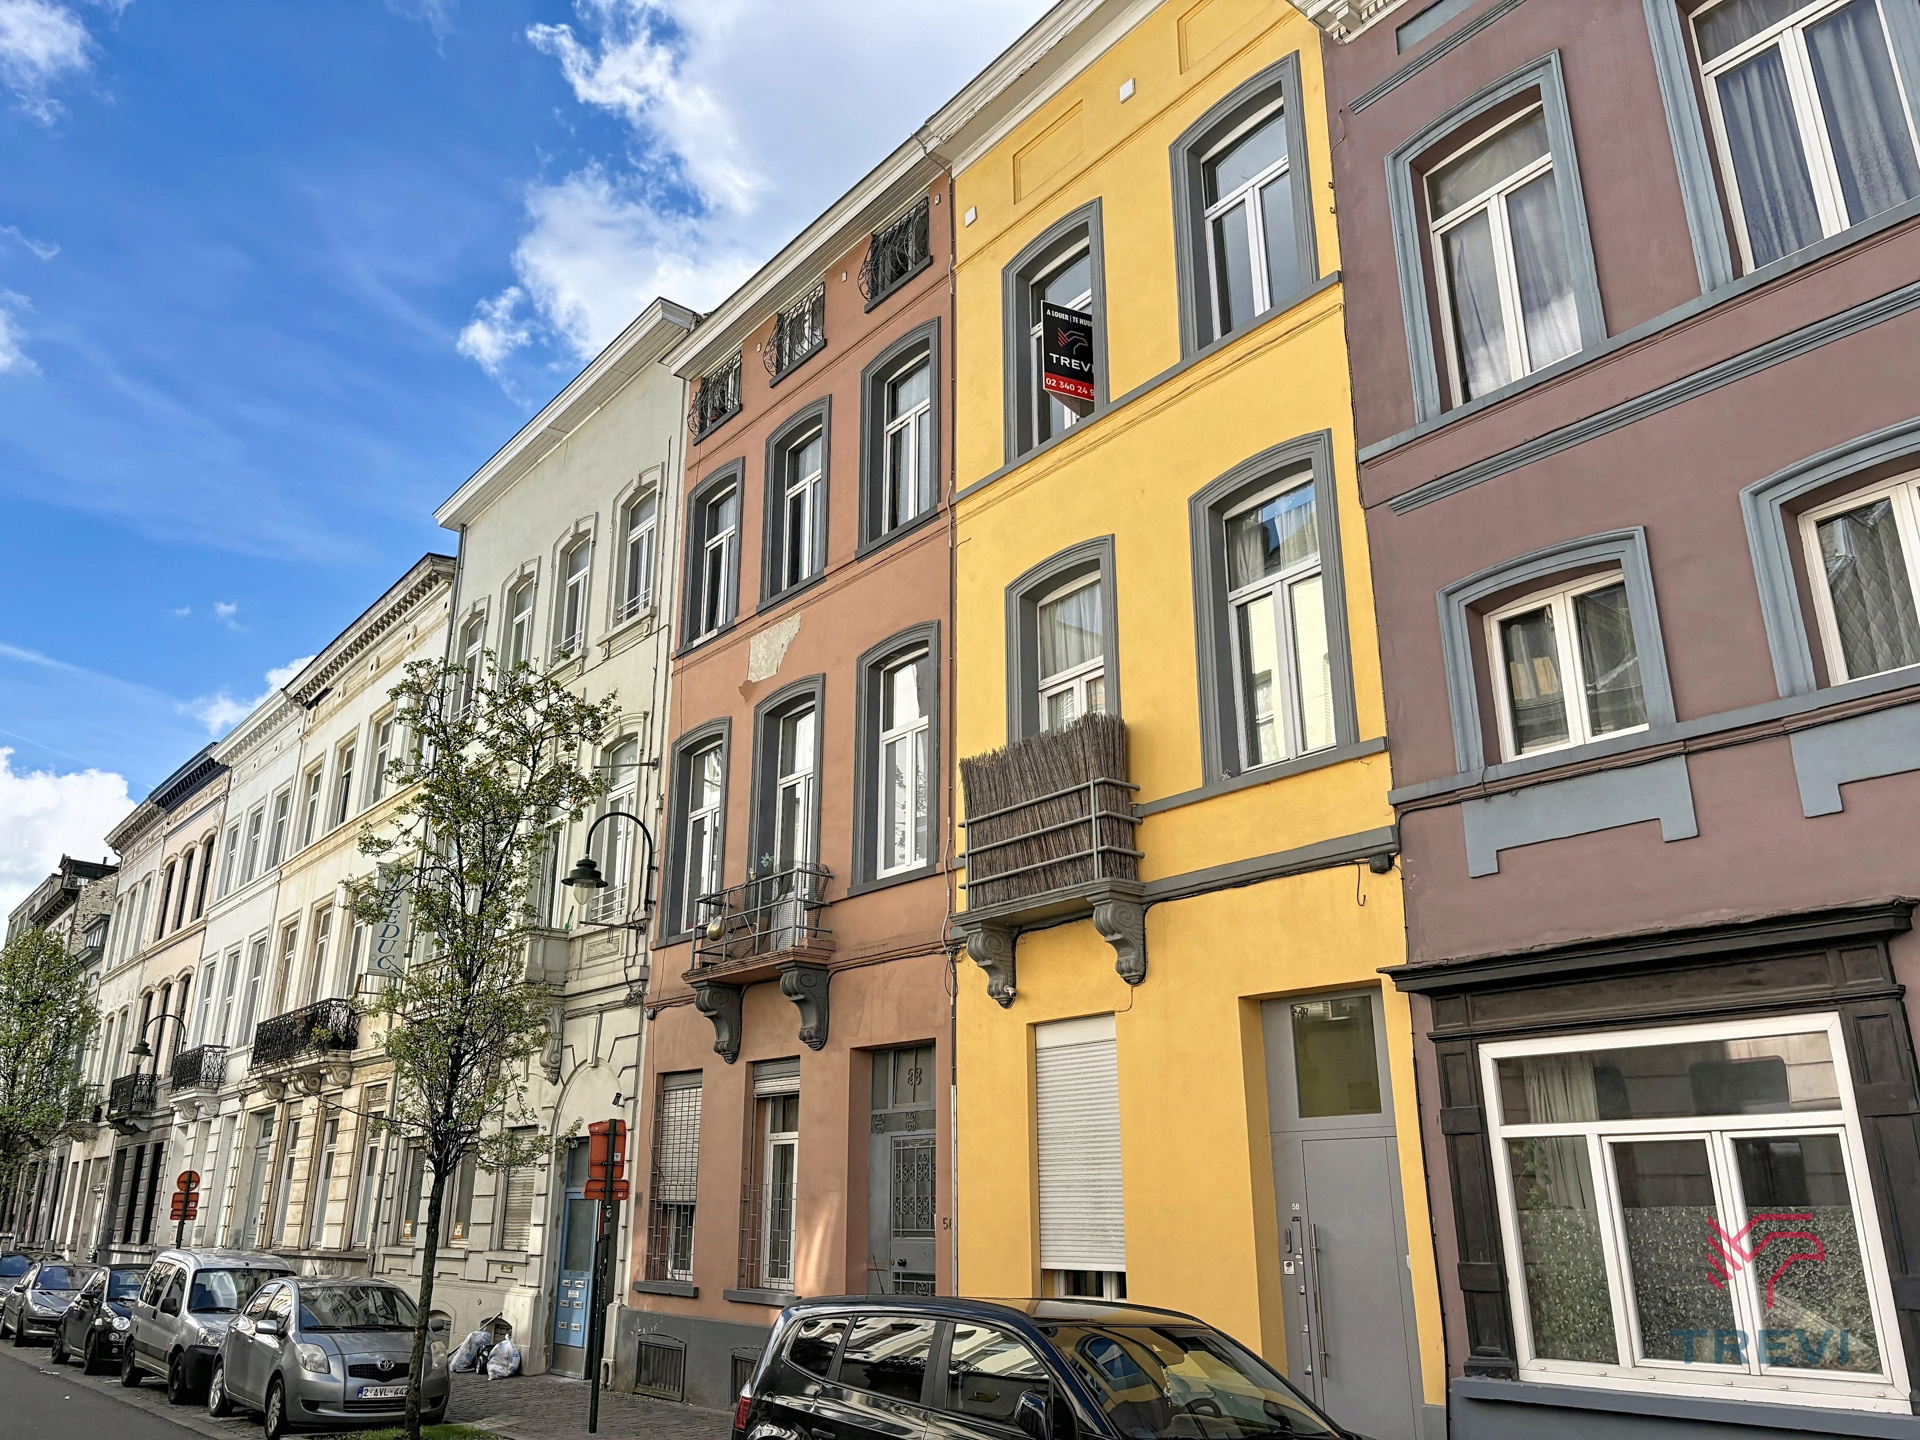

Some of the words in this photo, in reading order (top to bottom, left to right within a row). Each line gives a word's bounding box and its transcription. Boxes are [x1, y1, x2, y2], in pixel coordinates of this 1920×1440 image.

[1051, 310, 1069, 321] LOUER
[1072, 316, 1079, 324] TE
[1045, 377, 1057, 387] 02
[1059, 380, 1075, 391] 340
[1077, 385, 1088, 395] 24
